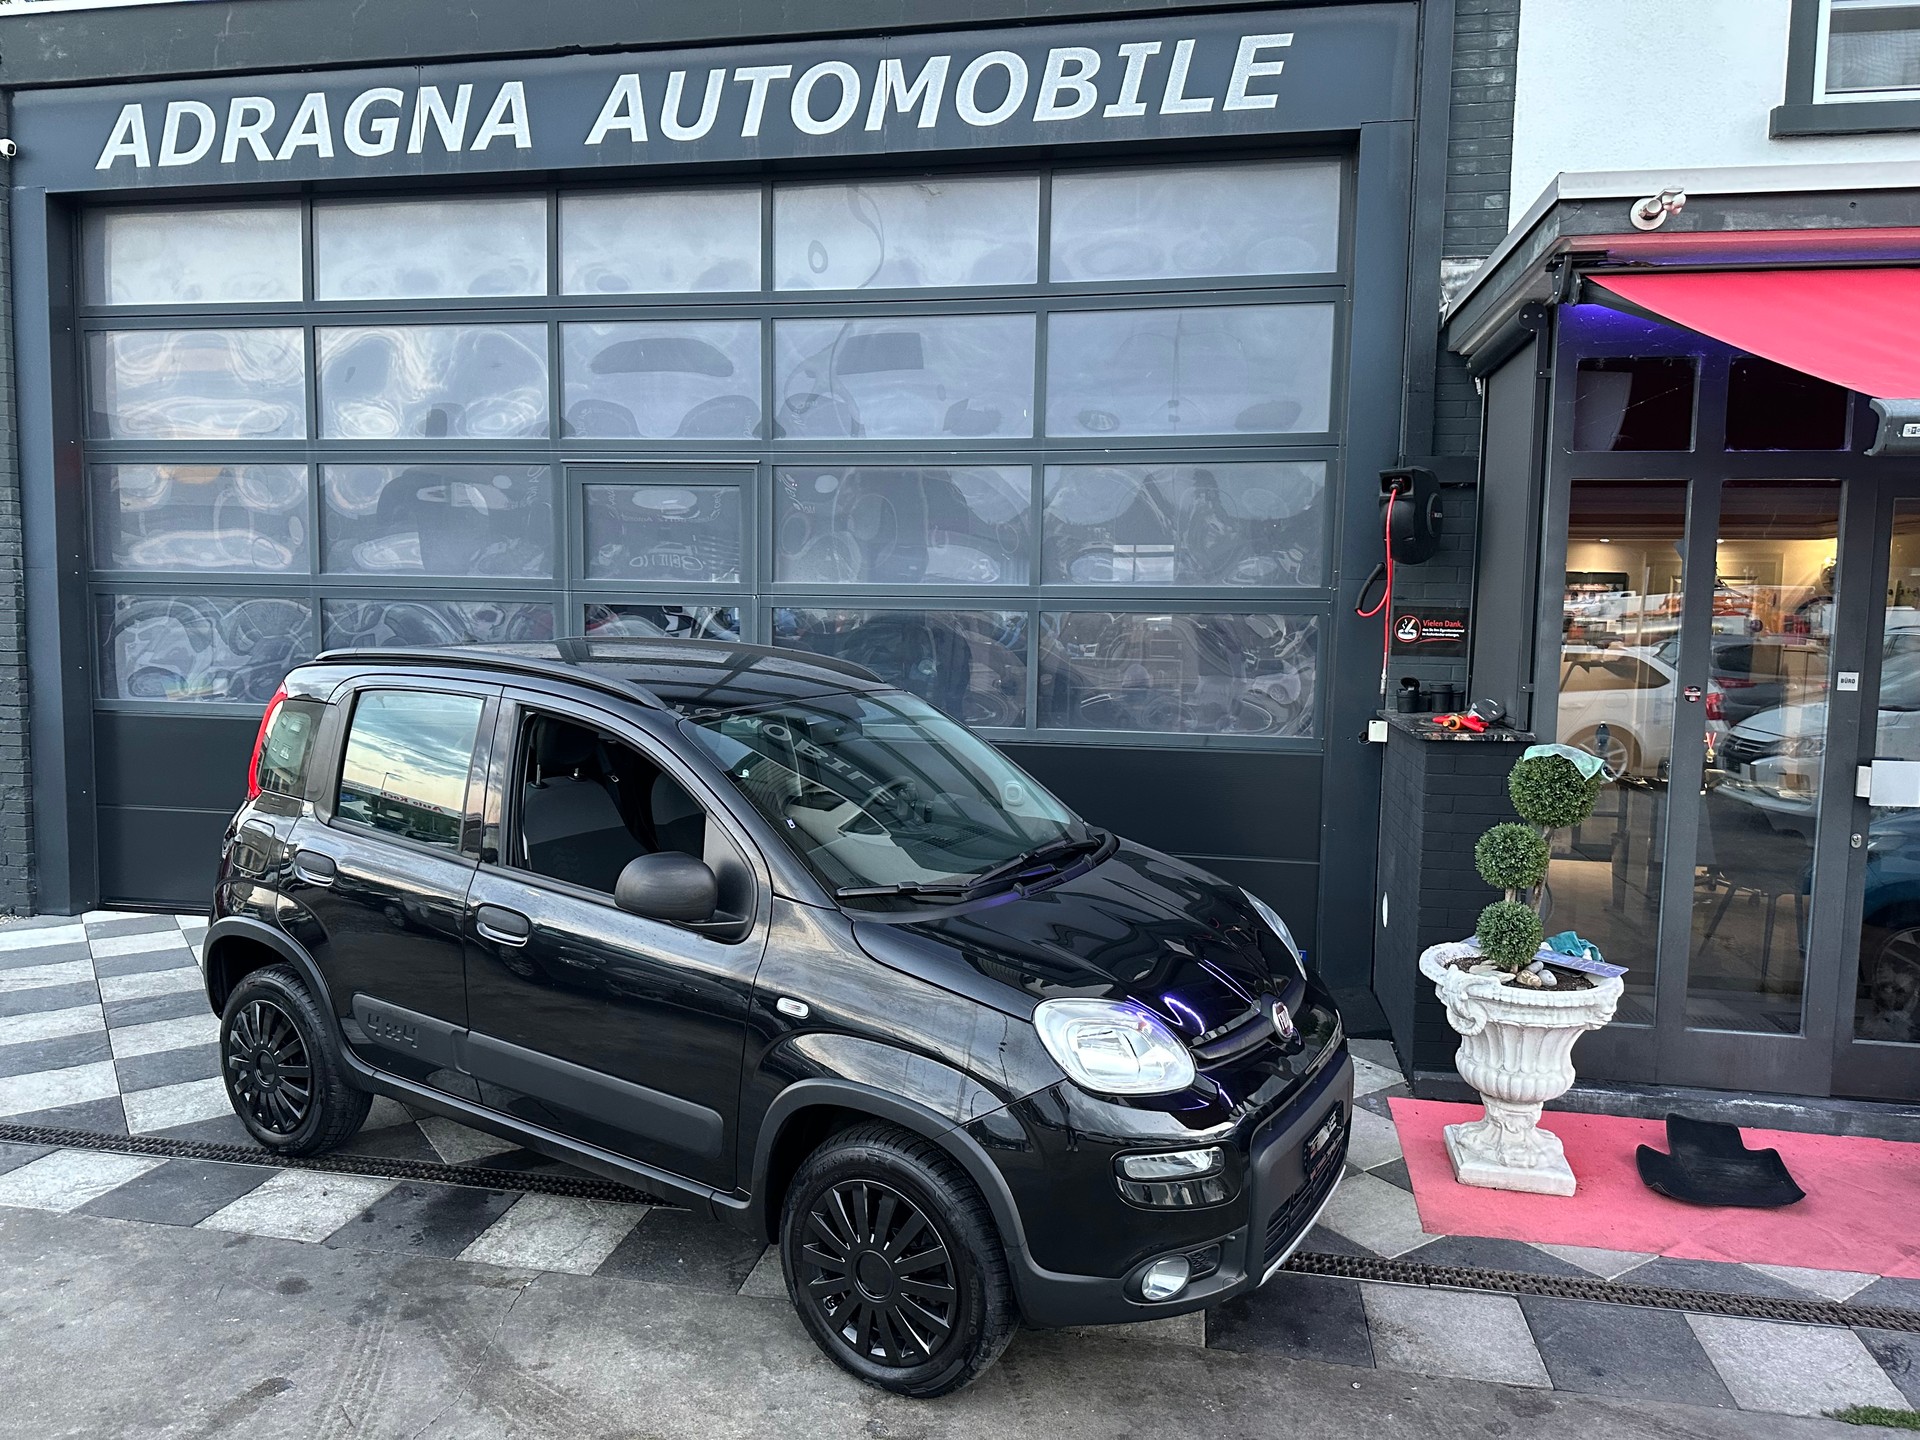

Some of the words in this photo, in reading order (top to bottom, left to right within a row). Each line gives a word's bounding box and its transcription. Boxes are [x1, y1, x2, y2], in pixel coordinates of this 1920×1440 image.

[95, 81, 532, 170] ADRAGNA
[584, 32, 1294, 145] AUTOMOBILE
[1840, 676, 1855, 684] BÜRO
[367, 1012, 418, 1049] 4x4
